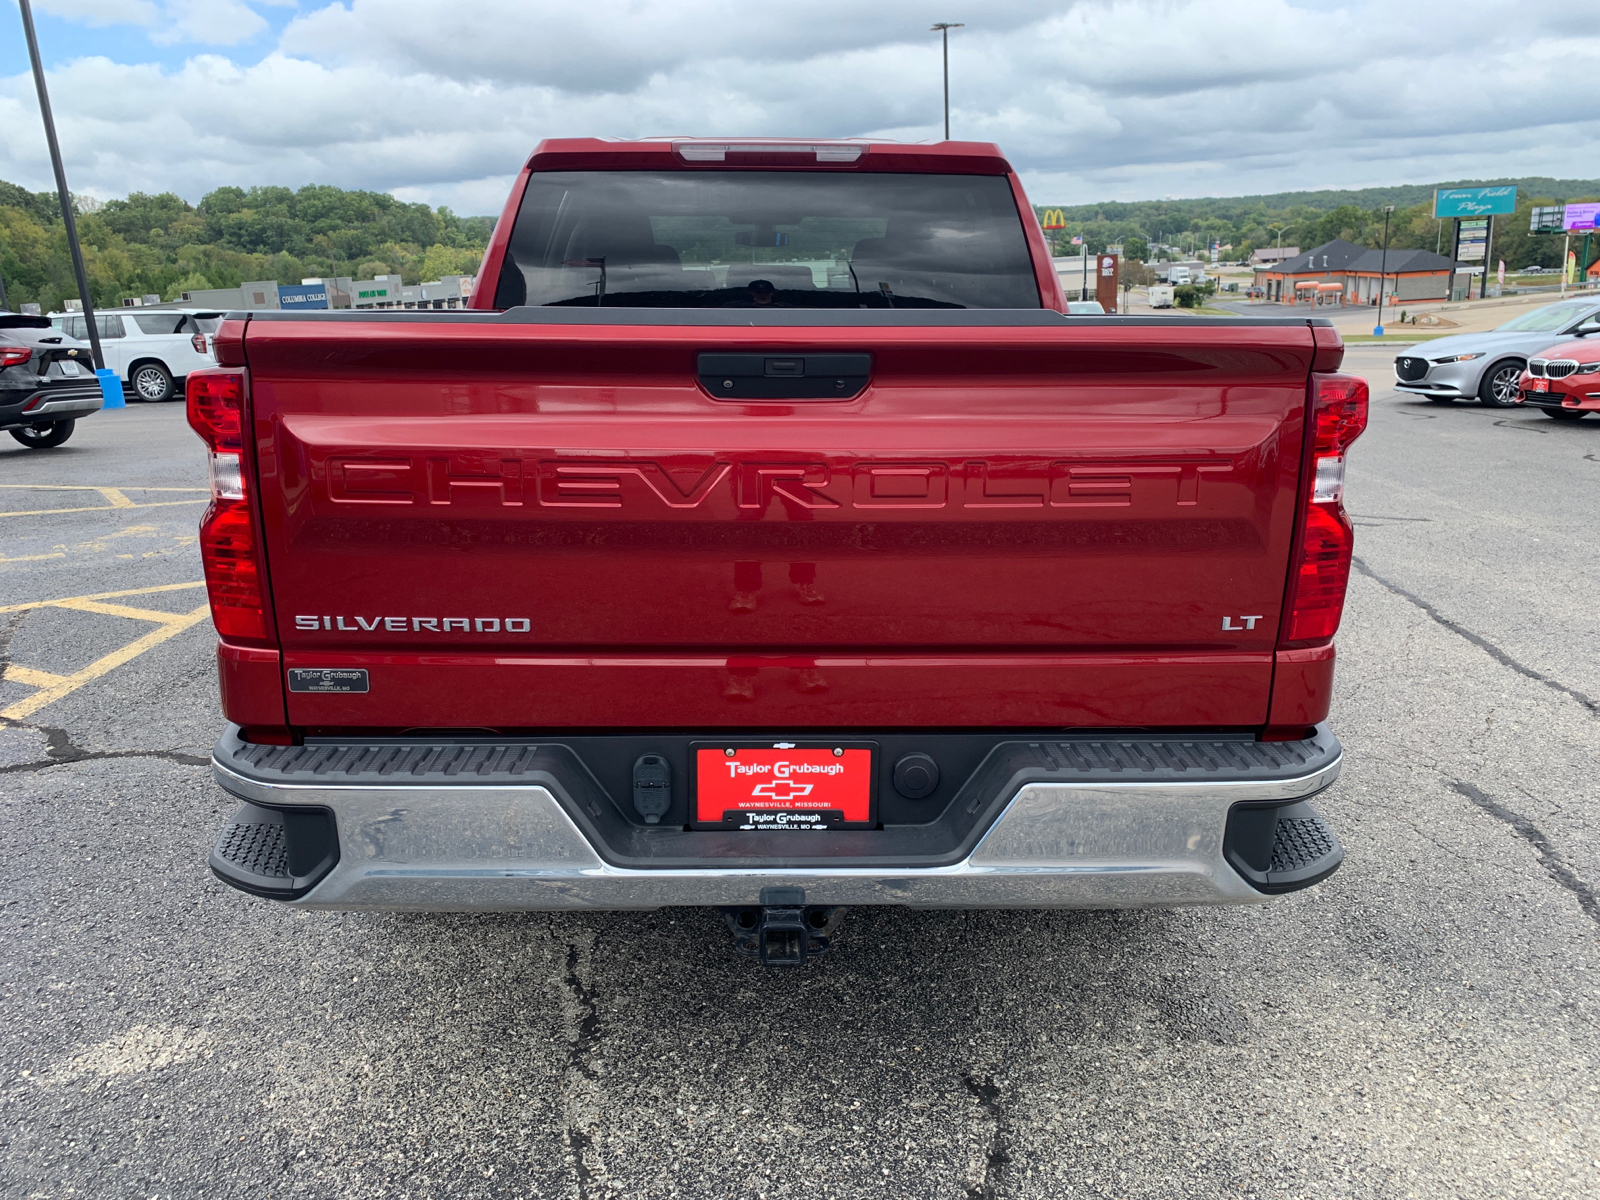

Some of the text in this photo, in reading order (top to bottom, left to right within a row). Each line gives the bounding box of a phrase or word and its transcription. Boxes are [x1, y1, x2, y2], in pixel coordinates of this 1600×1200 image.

[1442, 187, 1512, 200] Town Field
[282, 293, 327, 304] COLUMBIA COLLEGE
[325, 456, 1234, 509] CHEVROLET
[294, 615, 532, 633] SILVERADO
[1221, 614, 1264, 631] LT
[294, 670, 362, 681] Taylor Grubaugh
[725, 761, 844, 778] Taylor Grubaugh
[738, 801, 793, 809] WAYNESVILLE,
[746, 813, 821, 823] Taylor Grubaugh
